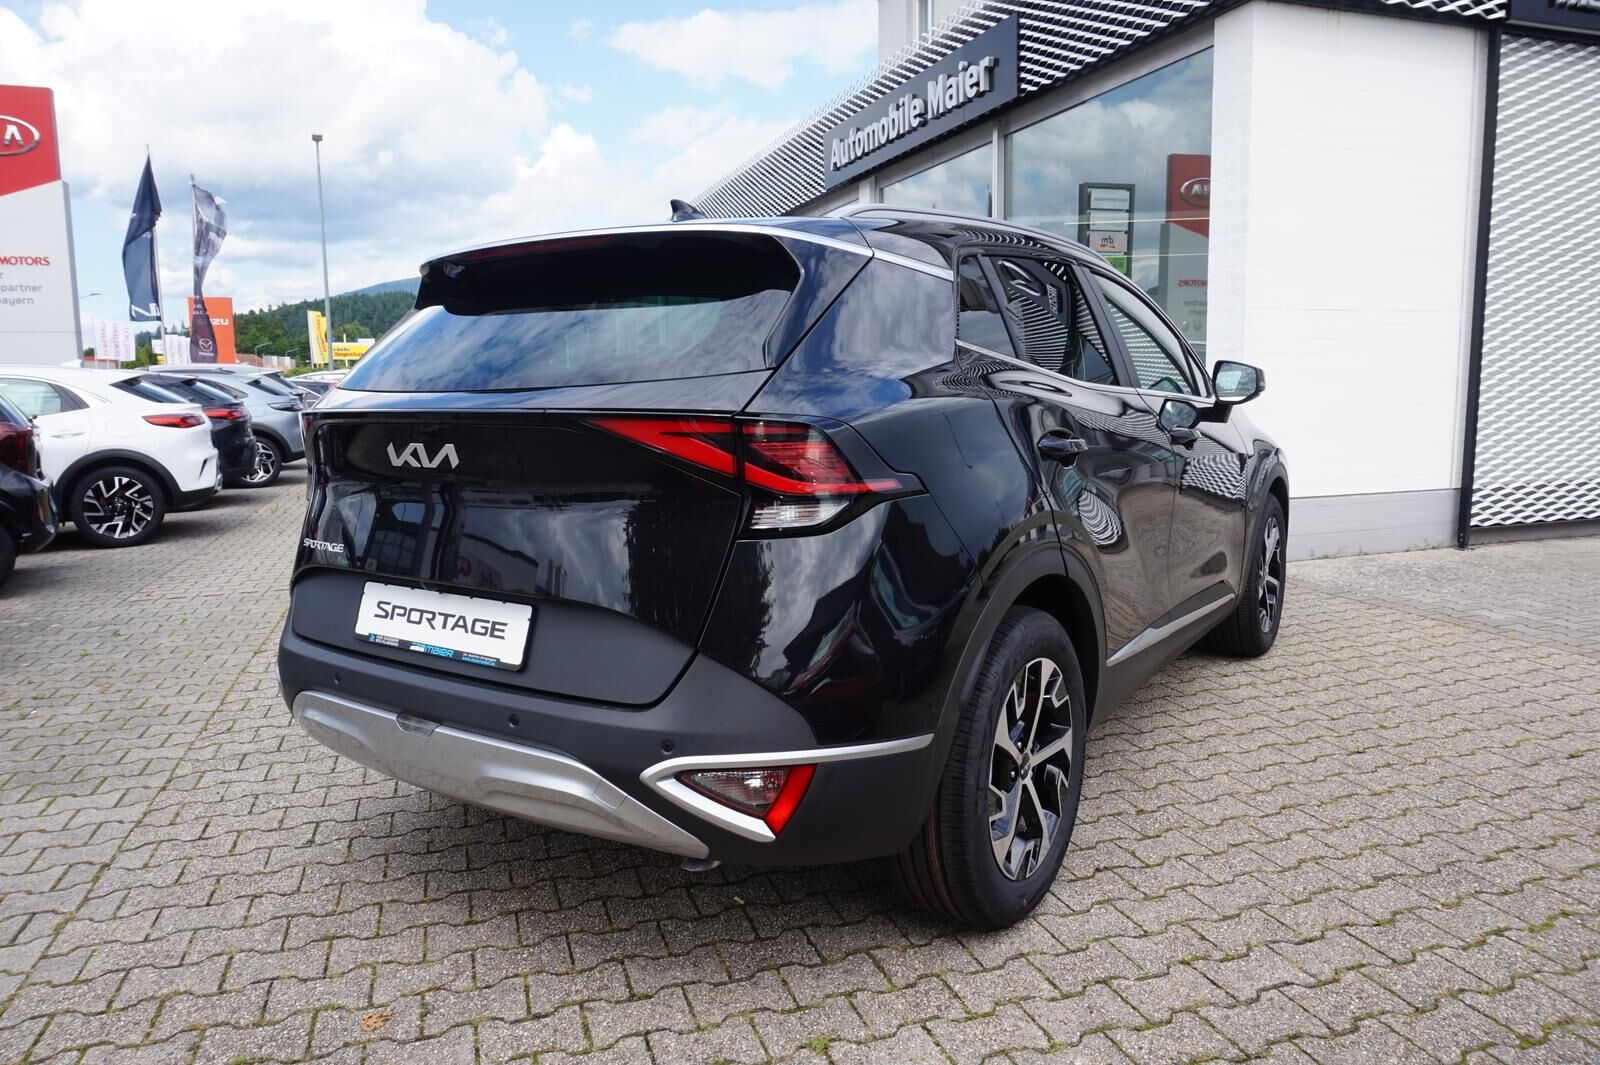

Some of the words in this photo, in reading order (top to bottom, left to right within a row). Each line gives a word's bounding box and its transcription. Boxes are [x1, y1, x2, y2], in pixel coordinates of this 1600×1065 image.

[830, 93, 925, 171] Automobile
[927, 56, 995, 120] Maier
[387, 442, 460, 469] KIA
[303, 538, 345, 553] SPORTAGE
[373, 600, 509, 640] SPORTAGE
